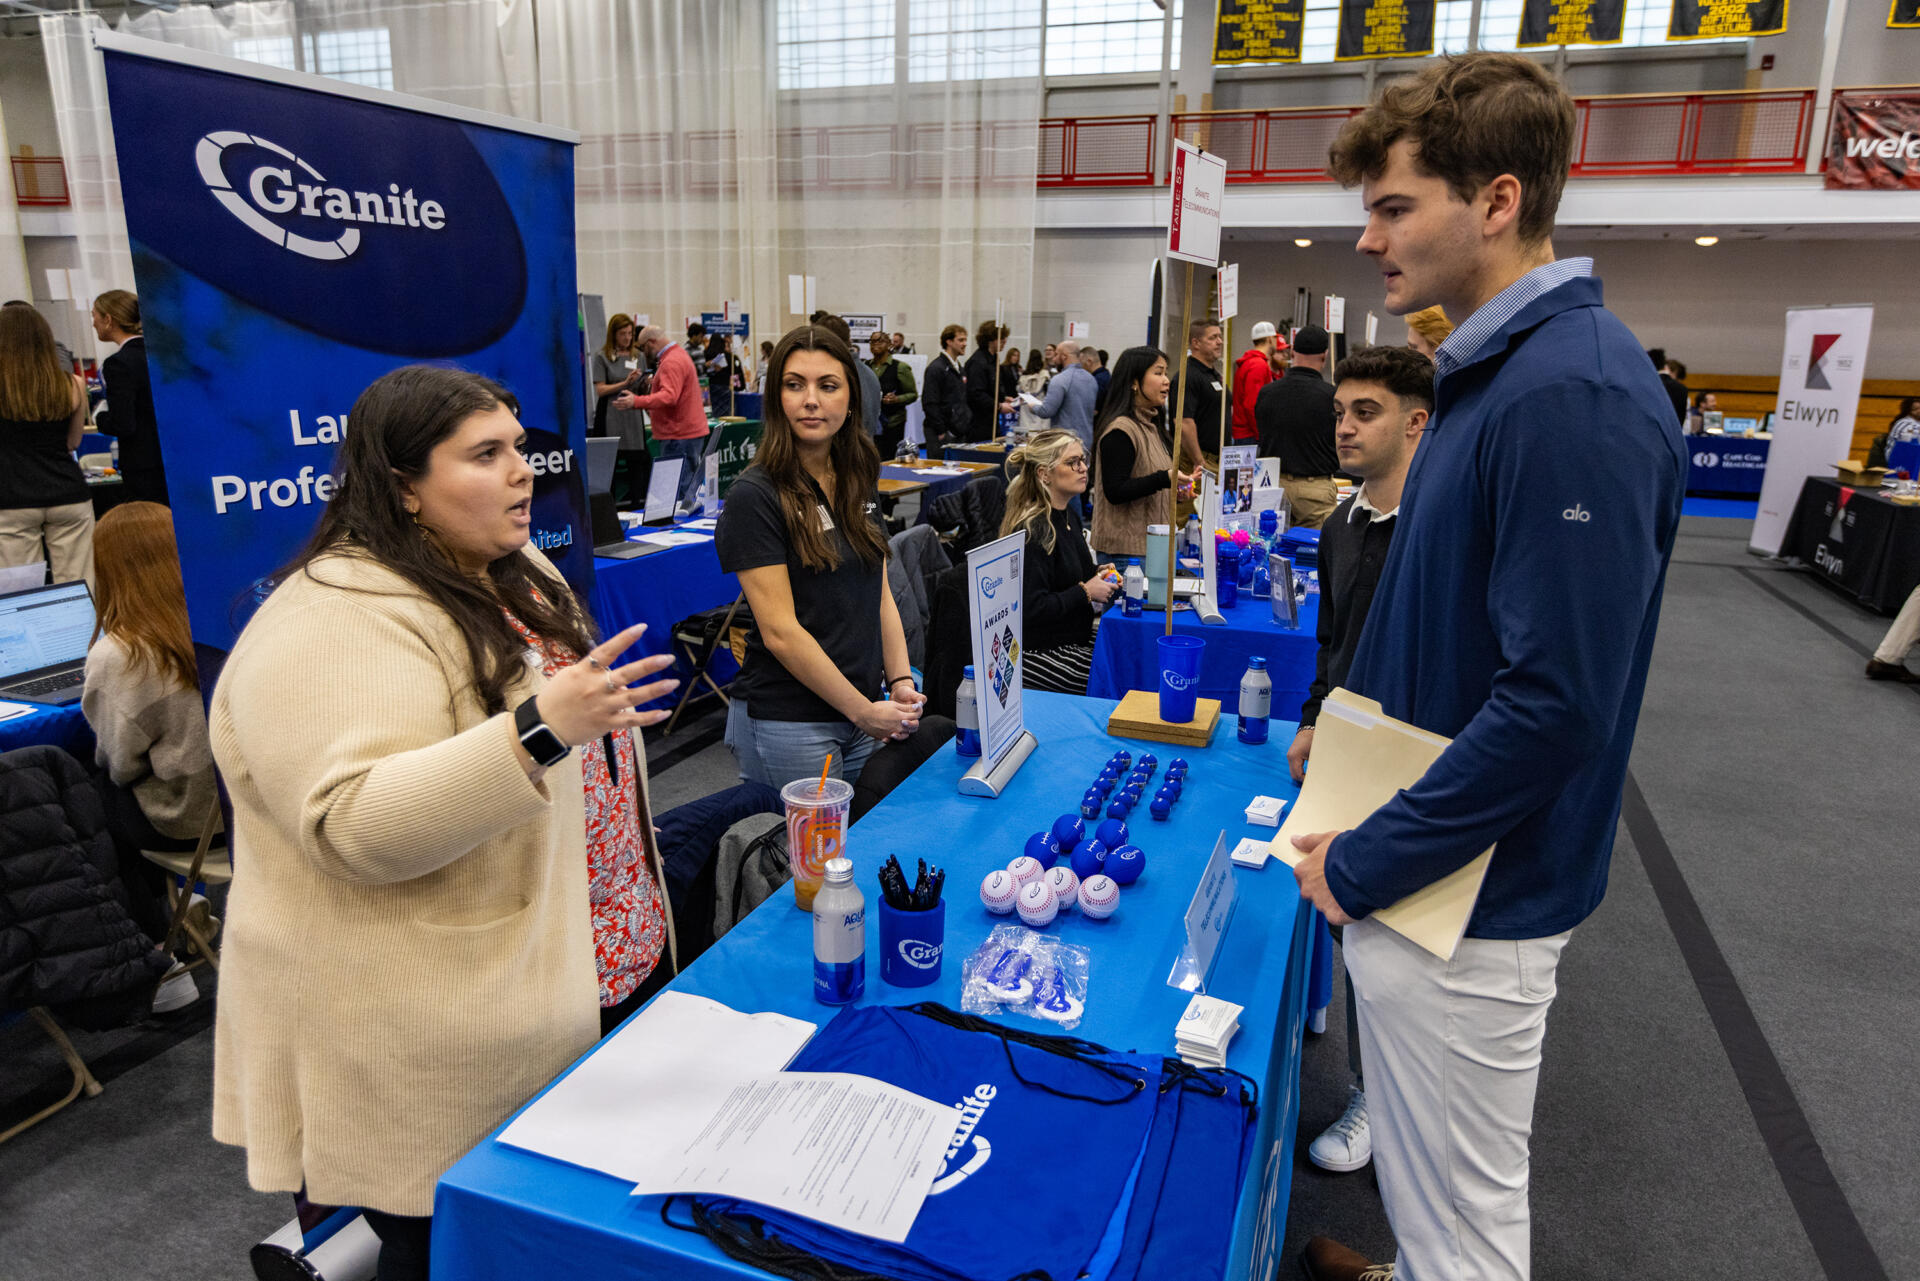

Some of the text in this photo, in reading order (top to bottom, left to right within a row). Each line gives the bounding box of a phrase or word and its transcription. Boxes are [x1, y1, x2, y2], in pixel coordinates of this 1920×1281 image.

[1700, 13, 1752, 25] SOFTBALL
[1708, 4, 1748, 16] 2002
[1697, 22, 1752, 34] WRESTLING
[249, 166, 446, 230] Granite
[1782, 400, 1839, 427] Elwyn
[1562, 503, 1591, 522] alo
[1814, 543, 1844, 575] Elwyn
[984, 607, 1009, 630] AWARDS
